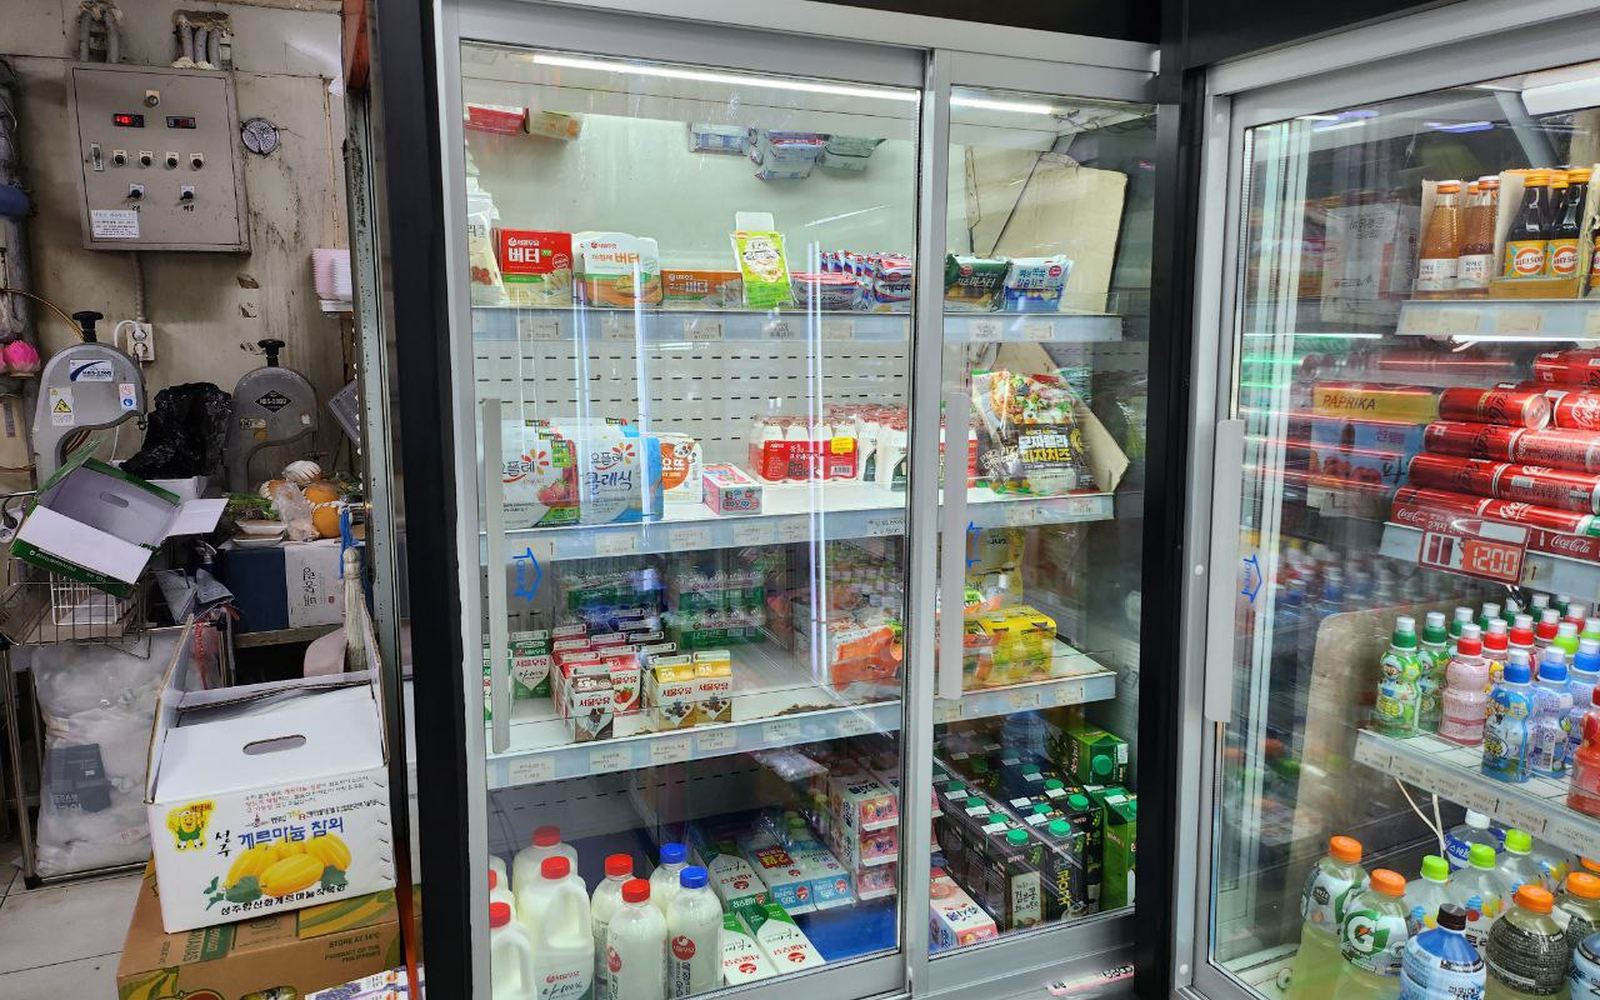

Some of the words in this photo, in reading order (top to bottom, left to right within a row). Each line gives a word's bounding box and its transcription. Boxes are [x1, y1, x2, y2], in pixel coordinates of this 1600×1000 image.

[508, 247, 540, 263] 버터
[614, 252, 640, 264] 버터
[685, 281, 708, 293] 버터
[1322, 394, 1377, 411] PAPRIKA
[590, 451, 624, 466] 요플레
[584, 470, 633, 496] 클래식
[1472, 545, 1518, 577] 1200
[516, 659, 548, 668] 서울우유
[661, 686, 692, 698] 서울우유
[698, 682, 729, 692] 서울우유
[579, 696, 611, 707] 서울우유
[311, 815, 344, 839] 참외
[215, 829, 232, 857] 성주
[1347, 916, 1377, 953] G
